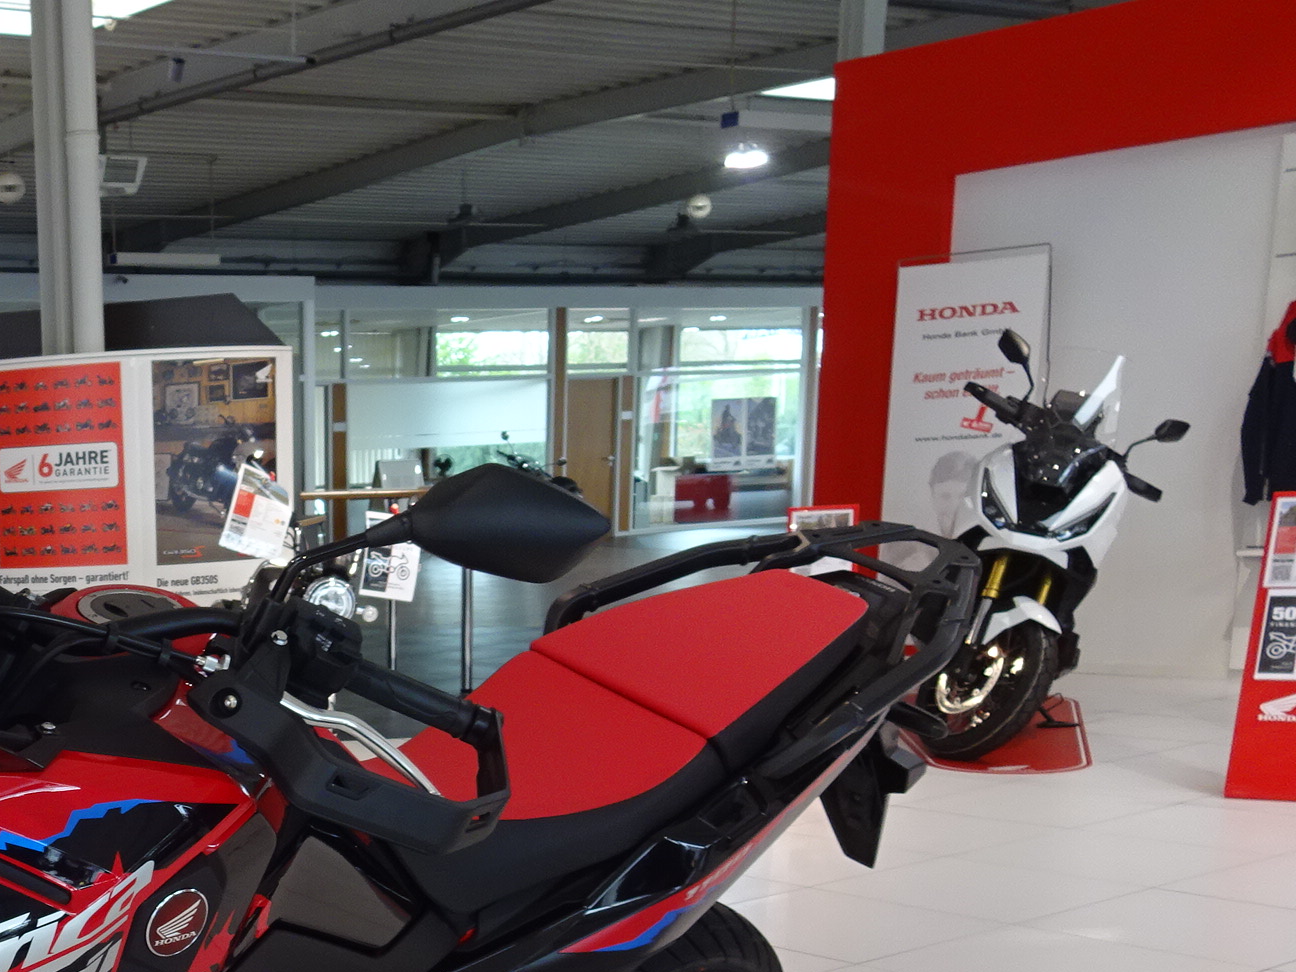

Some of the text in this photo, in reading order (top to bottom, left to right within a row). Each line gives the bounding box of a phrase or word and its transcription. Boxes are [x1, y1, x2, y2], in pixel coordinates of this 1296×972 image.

[917, 301, 1020, 321] HONDA
[922, 332, 951, 340] Honda
[38, 450, 109, 477] 6 JAHRE
[55, 466, 110, 477] GARANTIE
[0, 574, 30, 586] Fahrspaß
[31, 575, 48, 584] ohne
[50, 573, 77, 585] Sorgen
[157, 574, 219, 587] Die neue GB350S
[154, 931, 197, 947] HONDA
